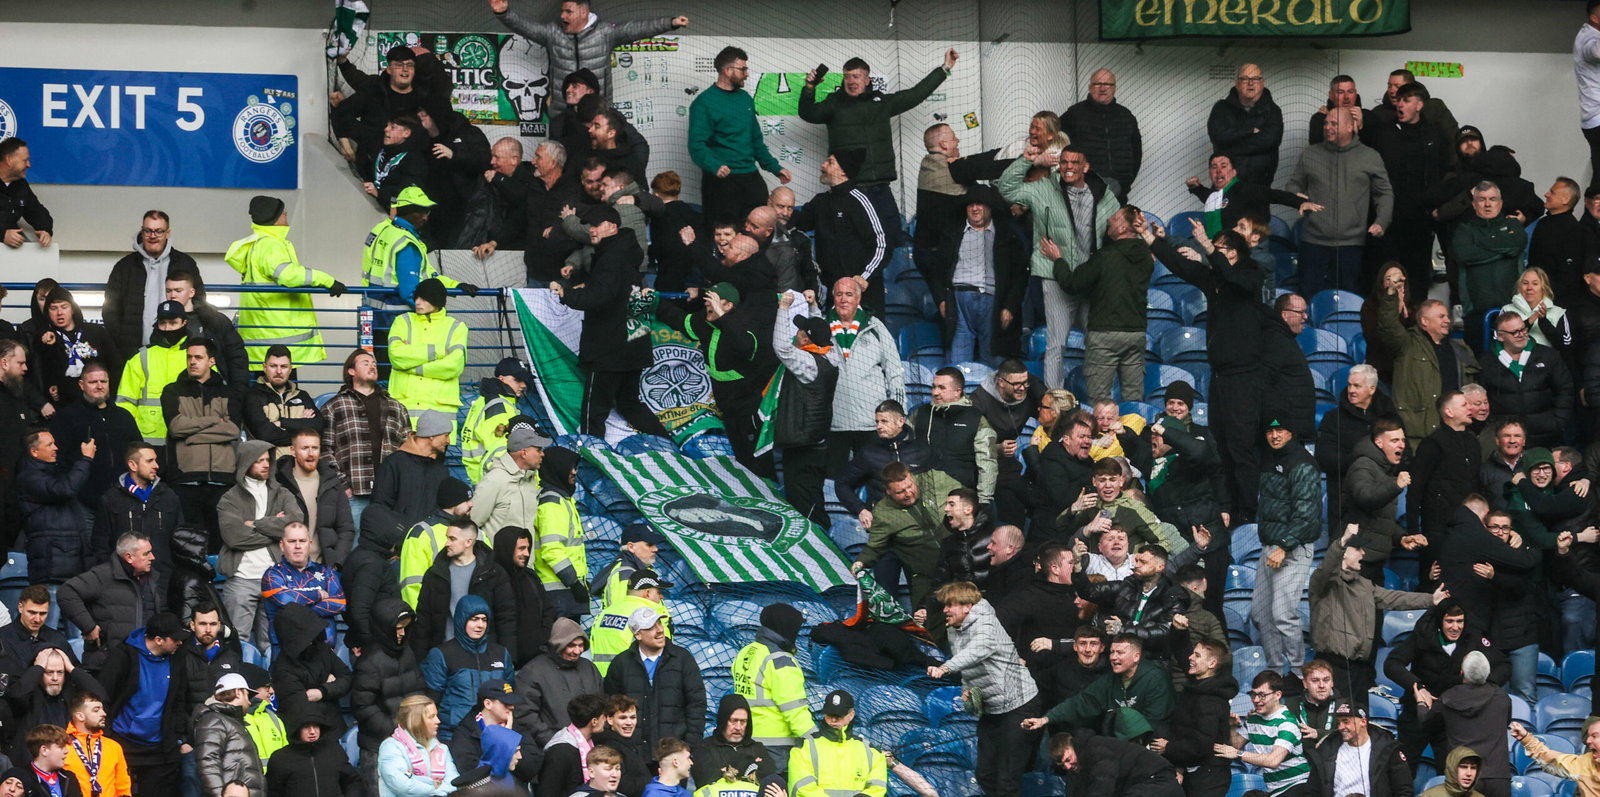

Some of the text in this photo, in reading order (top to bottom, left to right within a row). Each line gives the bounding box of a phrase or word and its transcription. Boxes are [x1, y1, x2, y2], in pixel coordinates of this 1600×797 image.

[444, 68, 494, 86] LTIC
[42, 83, 205, 131] EXIT 5
[240, 106, 282, 124] RANGERS
[650, 329, 692, 343] 194
[653, 348, 706, 371] UPPORTERS
[602, 615, 627, 629] POLICE
